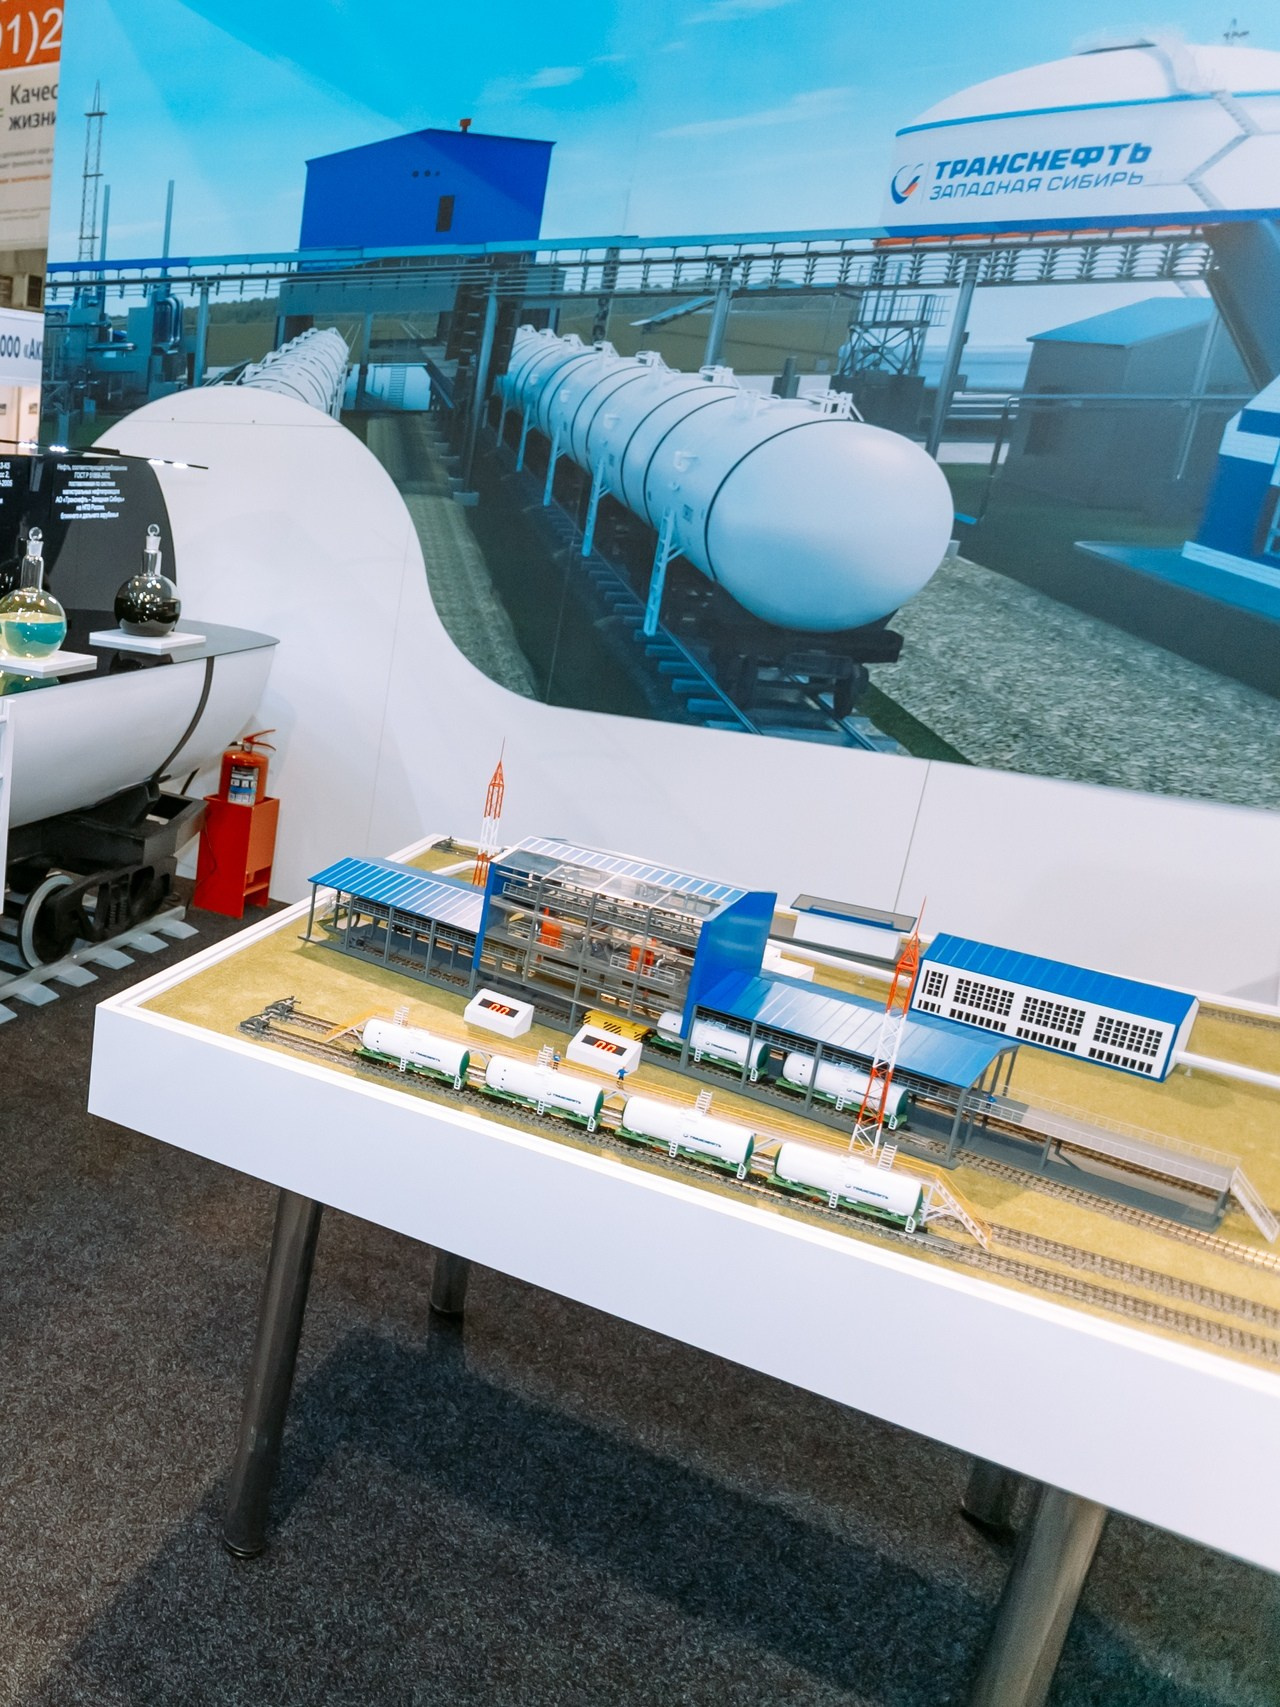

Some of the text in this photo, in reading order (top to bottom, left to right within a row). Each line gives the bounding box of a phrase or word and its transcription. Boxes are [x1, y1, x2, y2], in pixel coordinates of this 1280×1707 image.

[10, 84, 58, 105] Качес
[935, 142, 1152, 180] ТРАНСНЕФТЬ
[929, 171, 1144, 201] ЗАПАДНАЯ СИБИРЬ
[0, 334, 20, 358] ООО
